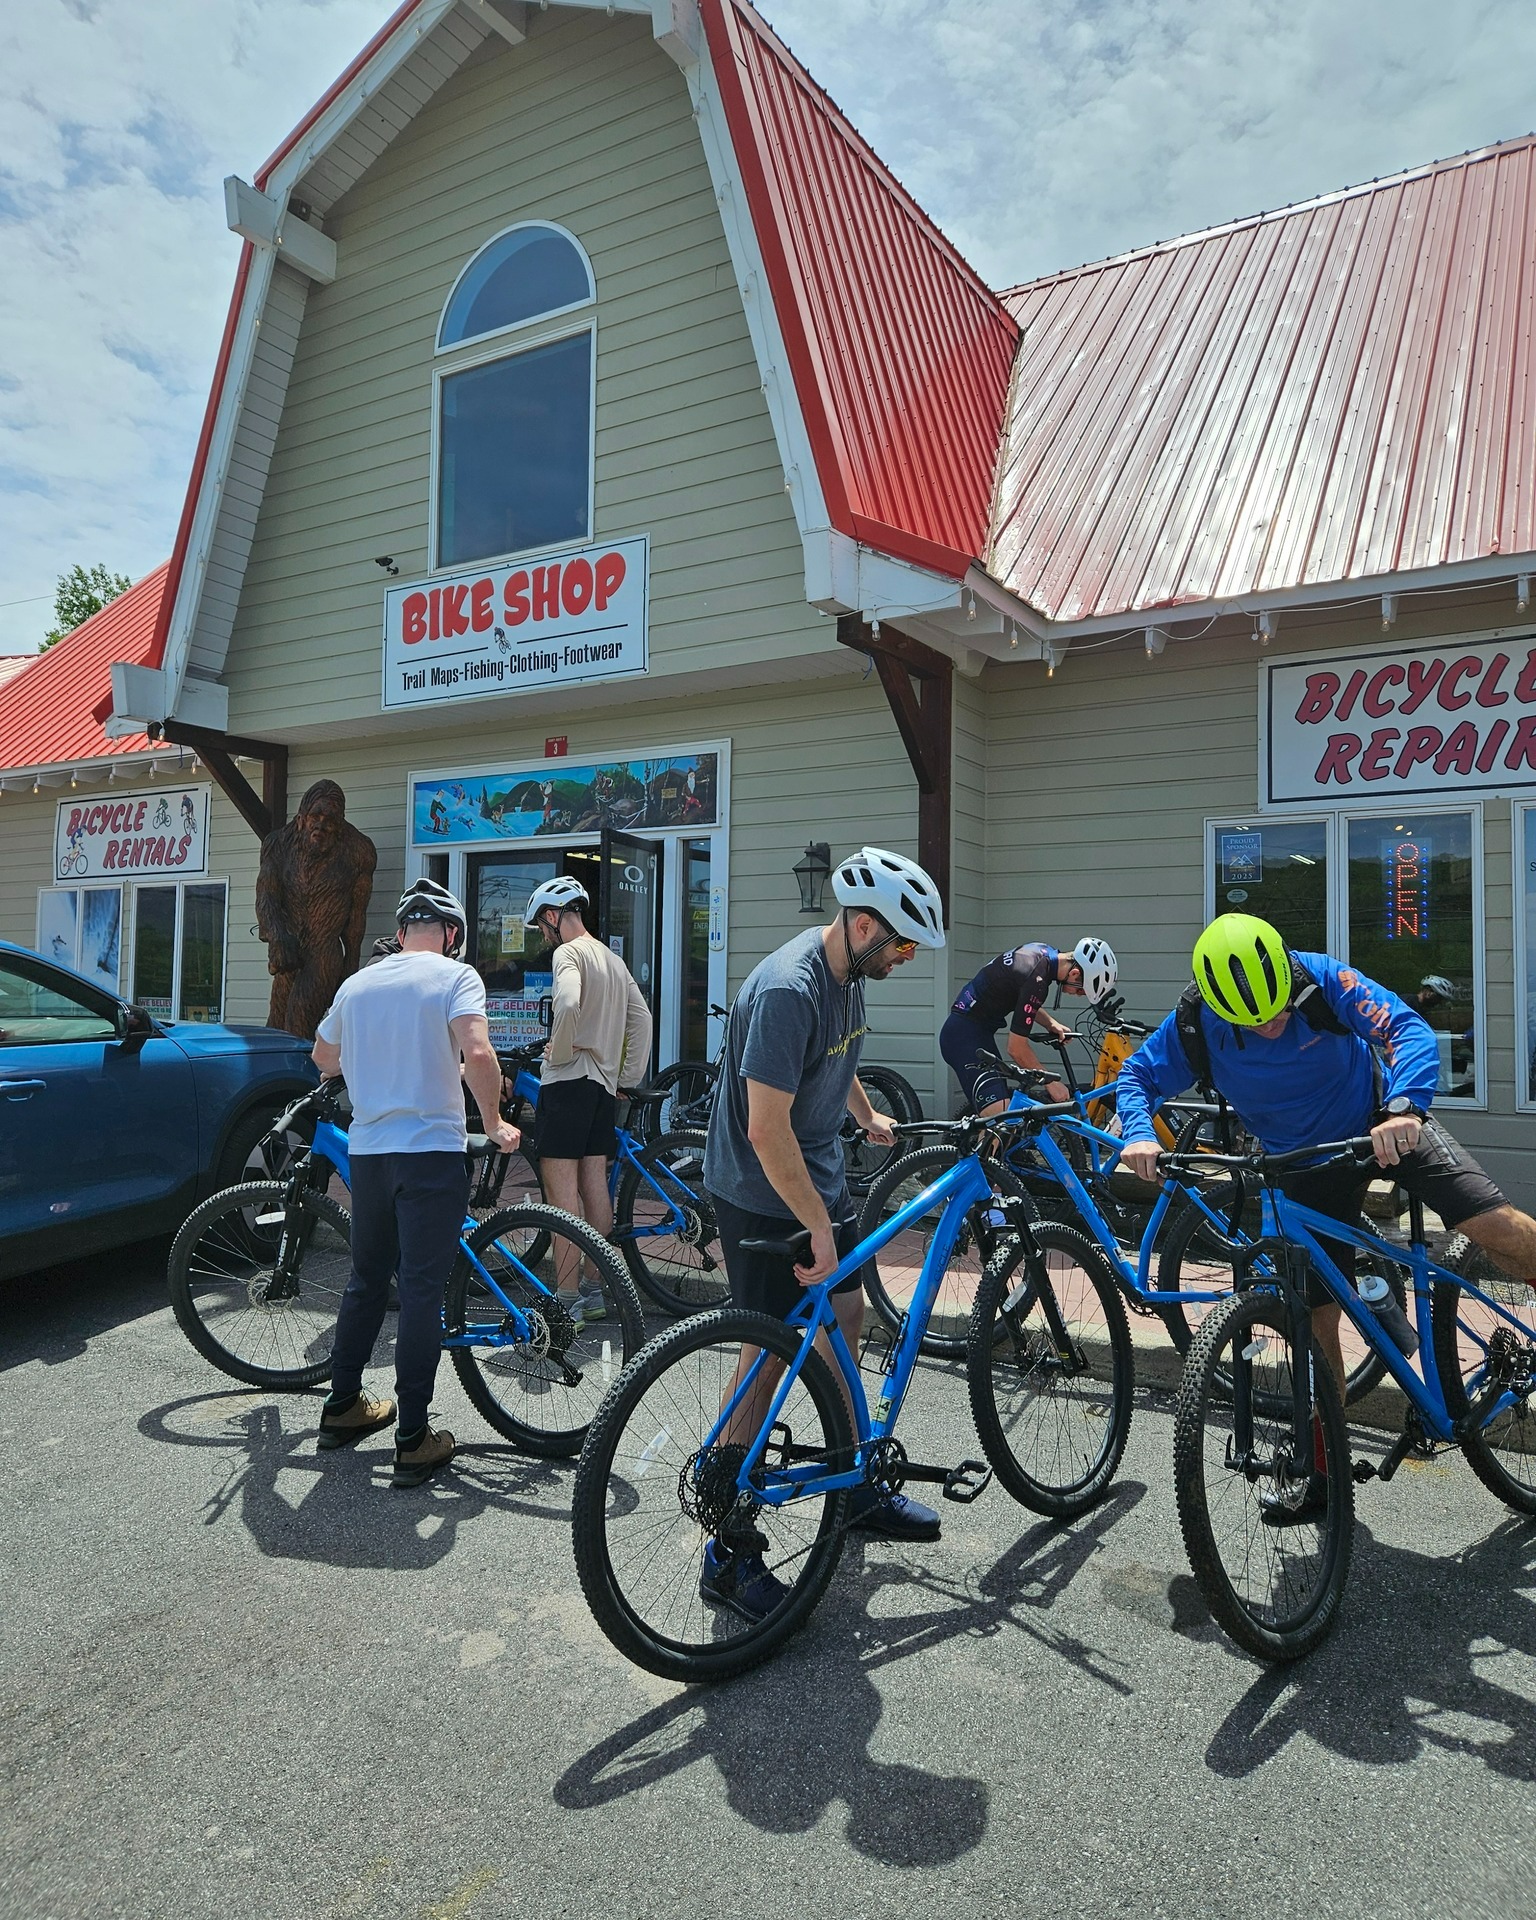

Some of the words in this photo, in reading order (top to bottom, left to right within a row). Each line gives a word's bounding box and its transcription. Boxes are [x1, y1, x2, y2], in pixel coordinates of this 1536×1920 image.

[402, 577, 495, 645] BIKE
[503, 552, 626, 627] SHOP
[402, 669, 426, 691] Trail
[553, 742, 559, 755] 3
[66, 800, 148, 838] BICYCLE
[1229, 837, 1254, 845] PROUD
[102, 835, 192, 870] RENTALS
[1231, 872, 1253, 880] 2025
[619, 881, 648, 895] OAKLEY
[1396, 842, 1420, 936] OPEN
[485, 1001, 500, 1010] WE
[488, 1026, 507, 1034] OVE
[510, 1026, 518, 1034] IS
[521, 1026, 545, 1035] LOVE
[933, 1244, 951, 1282] CYCLE
[1318, 1593, 1335, 1624] WTB
